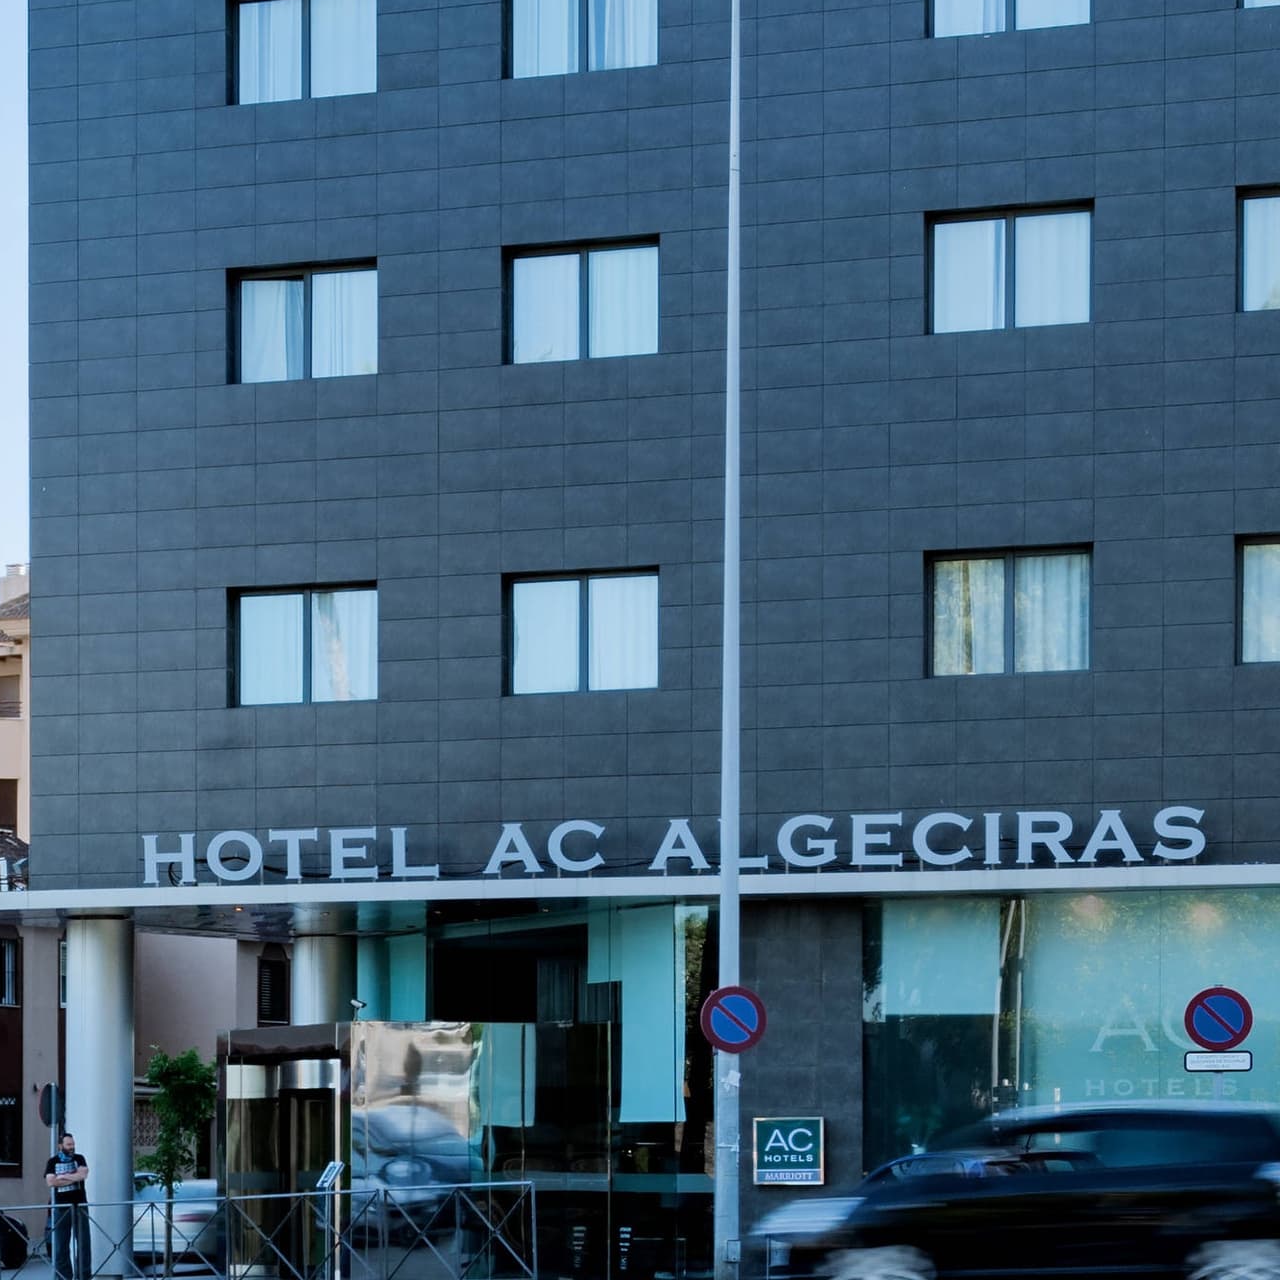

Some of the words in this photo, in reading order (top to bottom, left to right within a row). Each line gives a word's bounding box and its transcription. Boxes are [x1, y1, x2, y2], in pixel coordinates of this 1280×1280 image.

[142, 826, 439, 885] HOTEL
[482, 819, 606, 874] AC
[1085, 1077, 1238, 1097] HOTELS
[764, 1127, 814, 1152] AC
[764, 1154, 814, 1162] HOTELS
[765, 1172, 814, 1180] MARRIOTT
